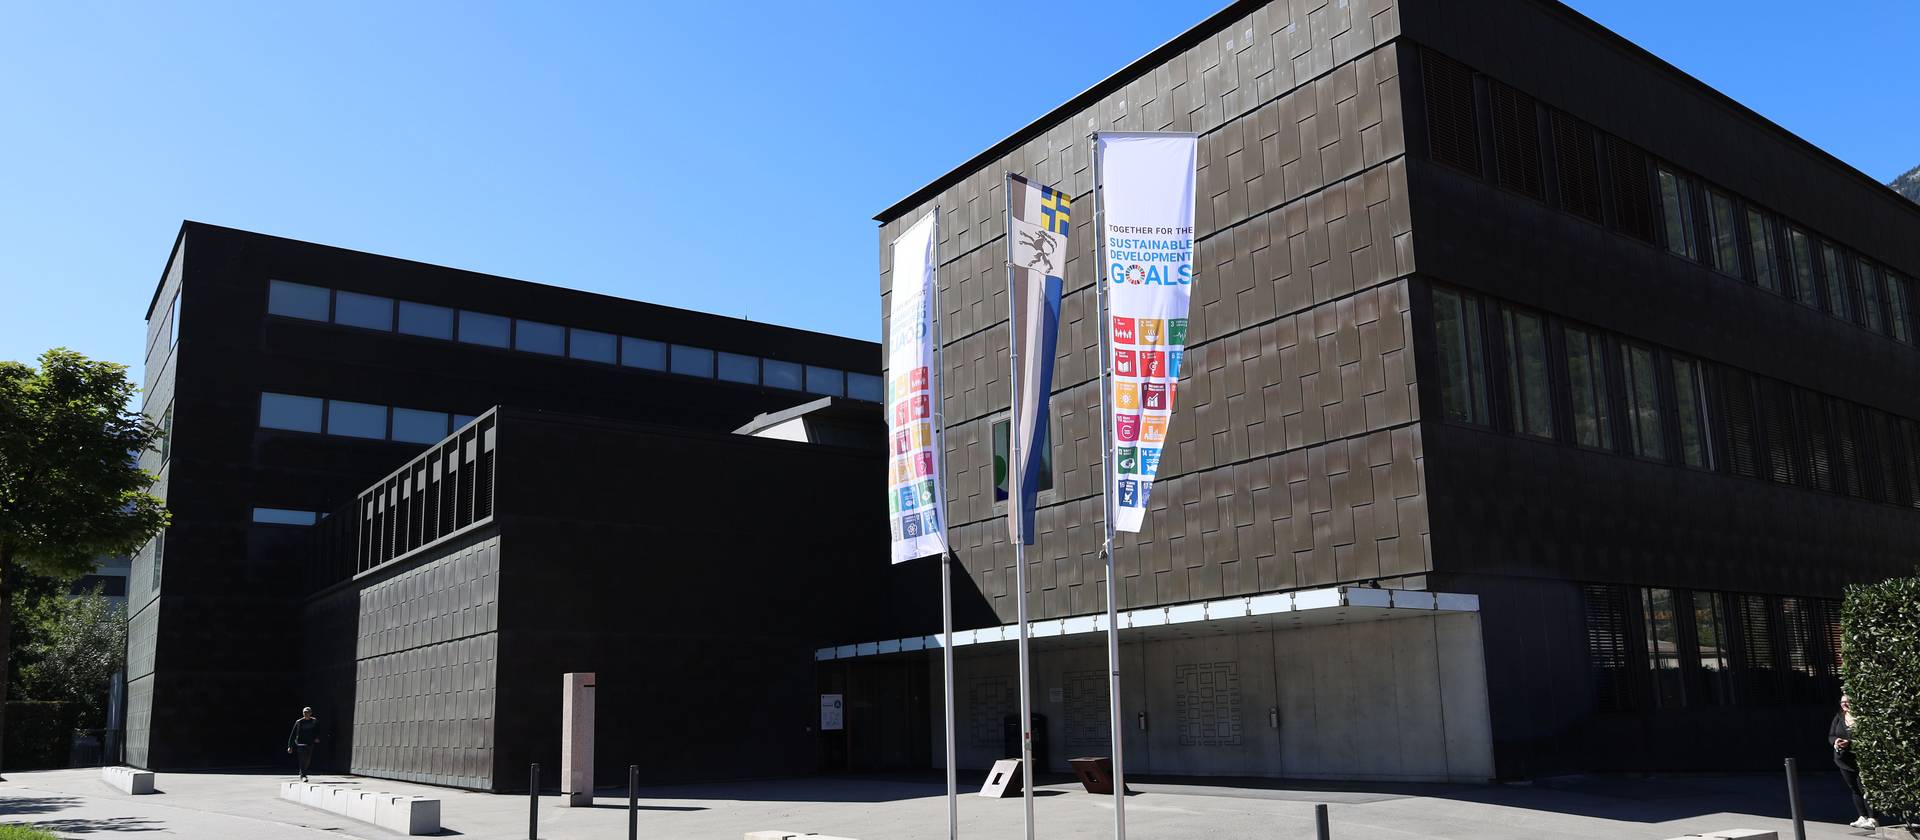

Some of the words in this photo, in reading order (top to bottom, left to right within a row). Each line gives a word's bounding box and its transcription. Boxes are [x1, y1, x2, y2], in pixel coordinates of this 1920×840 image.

[1109, 224, 1153, 234] TOGETHER
[1176, 226, 1193, 234] THE
[1110, 238, 1192, 250] SUSTAINABLE
[1110, 250, 1192, 262] DEVELOPMENT
[1111, 263, 1192, 286] GOALS
